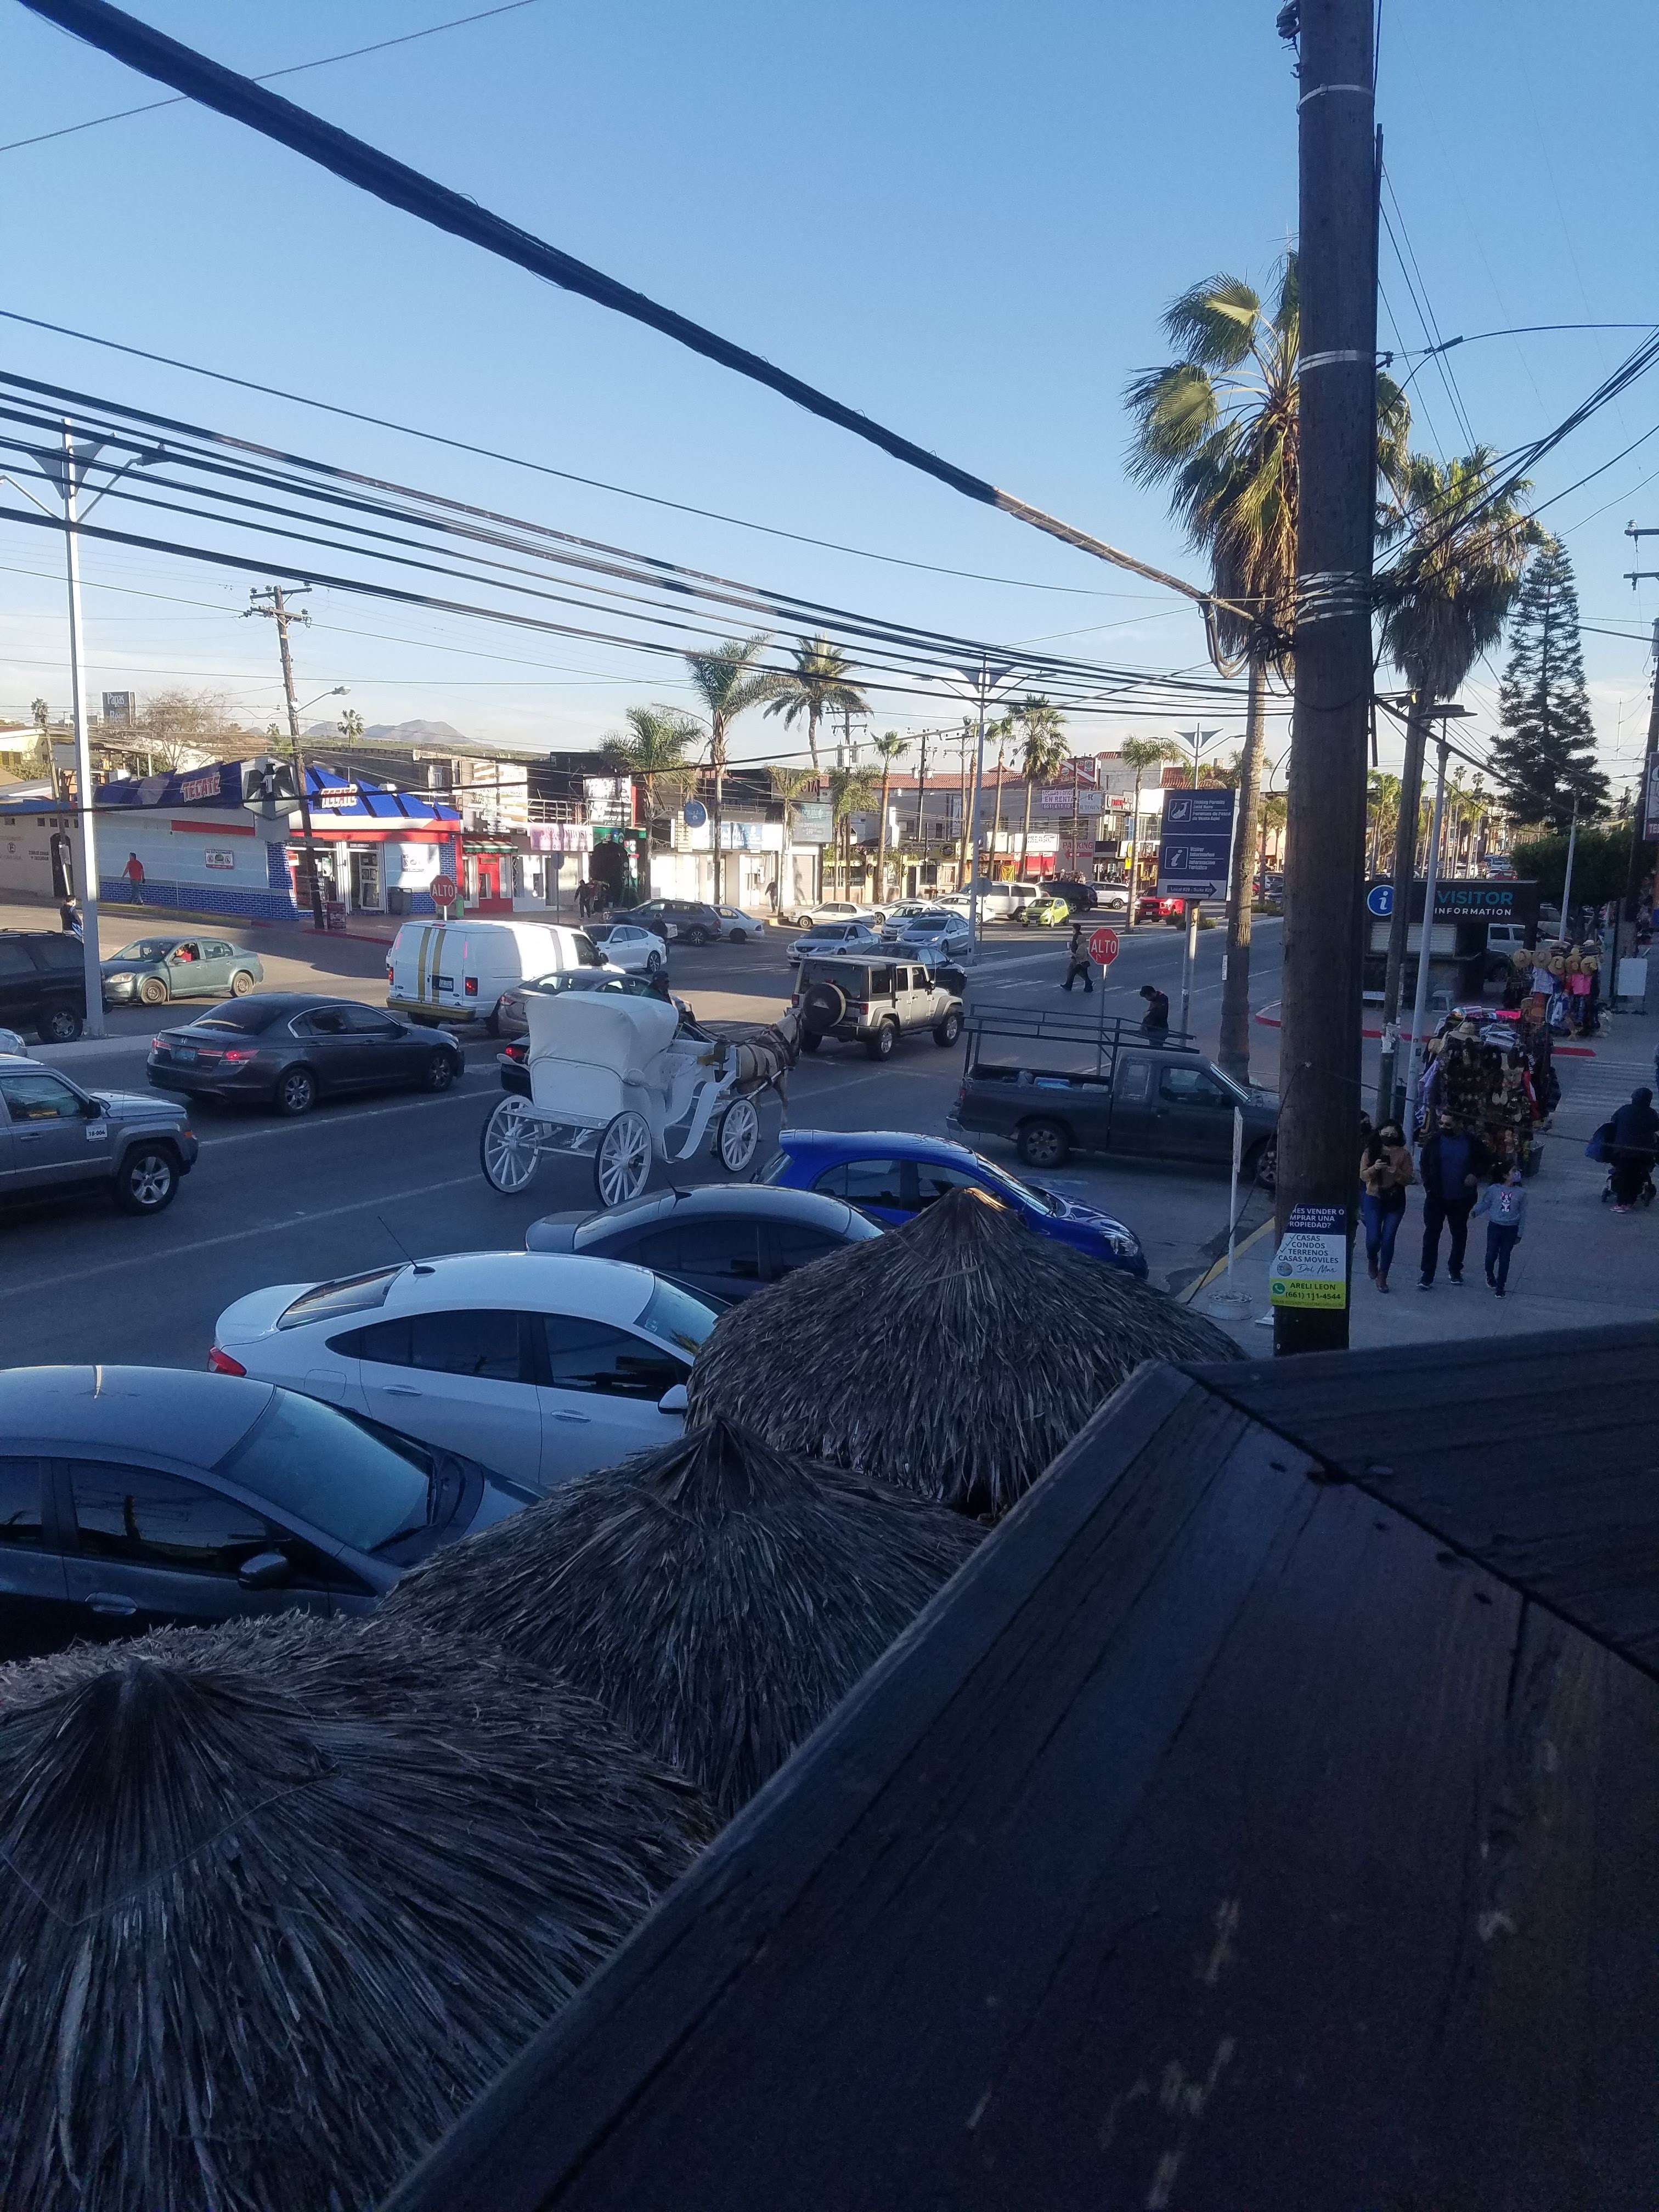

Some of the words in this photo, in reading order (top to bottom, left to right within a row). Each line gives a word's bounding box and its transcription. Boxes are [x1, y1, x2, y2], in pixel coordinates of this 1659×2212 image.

[106, 692, 125, 707] Papas
[180, 775, 221, 802] TECATE
[1062, 842, 1093, 850] PAKING
[432, 884, 454, 897] ALTO
[1437, 890, 1514, 905] VISITOR
[1435, 907, 1511, 916] INFORMATION
[1091, 939, 1116, 954] ALTO
[1288, 1248, 1329, 1256] TERRENOS
[1285, 1291, 1305, 1300] (661)
